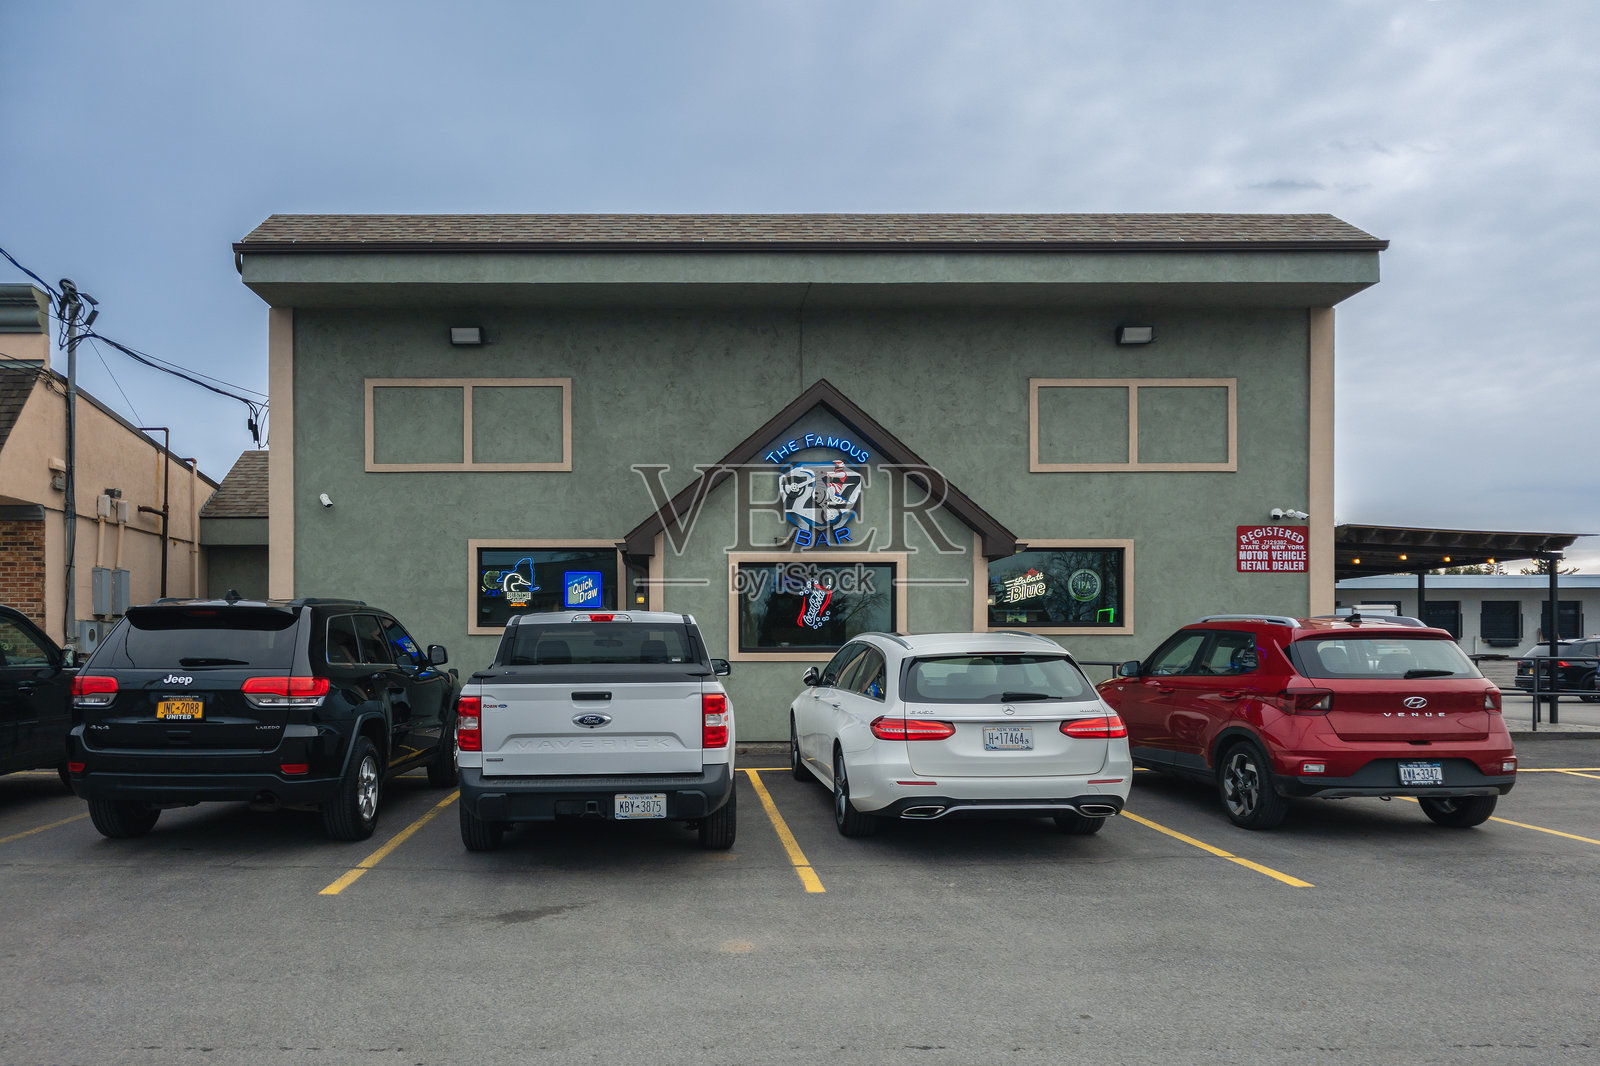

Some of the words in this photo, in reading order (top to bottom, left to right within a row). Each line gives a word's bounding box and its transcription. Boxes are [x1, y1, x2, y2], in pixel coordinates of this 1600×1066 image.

[765, 440, 800, 464] THE
[805, 433, 869, 463] FAMOUS
[795, 527, 853, 547] BAR
[1240, 527, 1304, 544] REGISTERED
[1239, 551, 1269, 560] MOTOR
[1272, 551, 1306, 560] VEHICLE
[1241, 561, 1270, 570] RETAIL
[1272, 561, 1305, 570] DEALER
[1014, 572, 1044, 585] Labatt
[573, 578, 593, 594] Quick
[1010, 582, 1046, 603] Blue
[580, 588, 598, 603] Draw
[163, 674, 193, 686] Jeep
[181, 703, 199, 714] 2088
[619, 801, 635, 813] KBY
[641, 801, 662, 813] 3875
